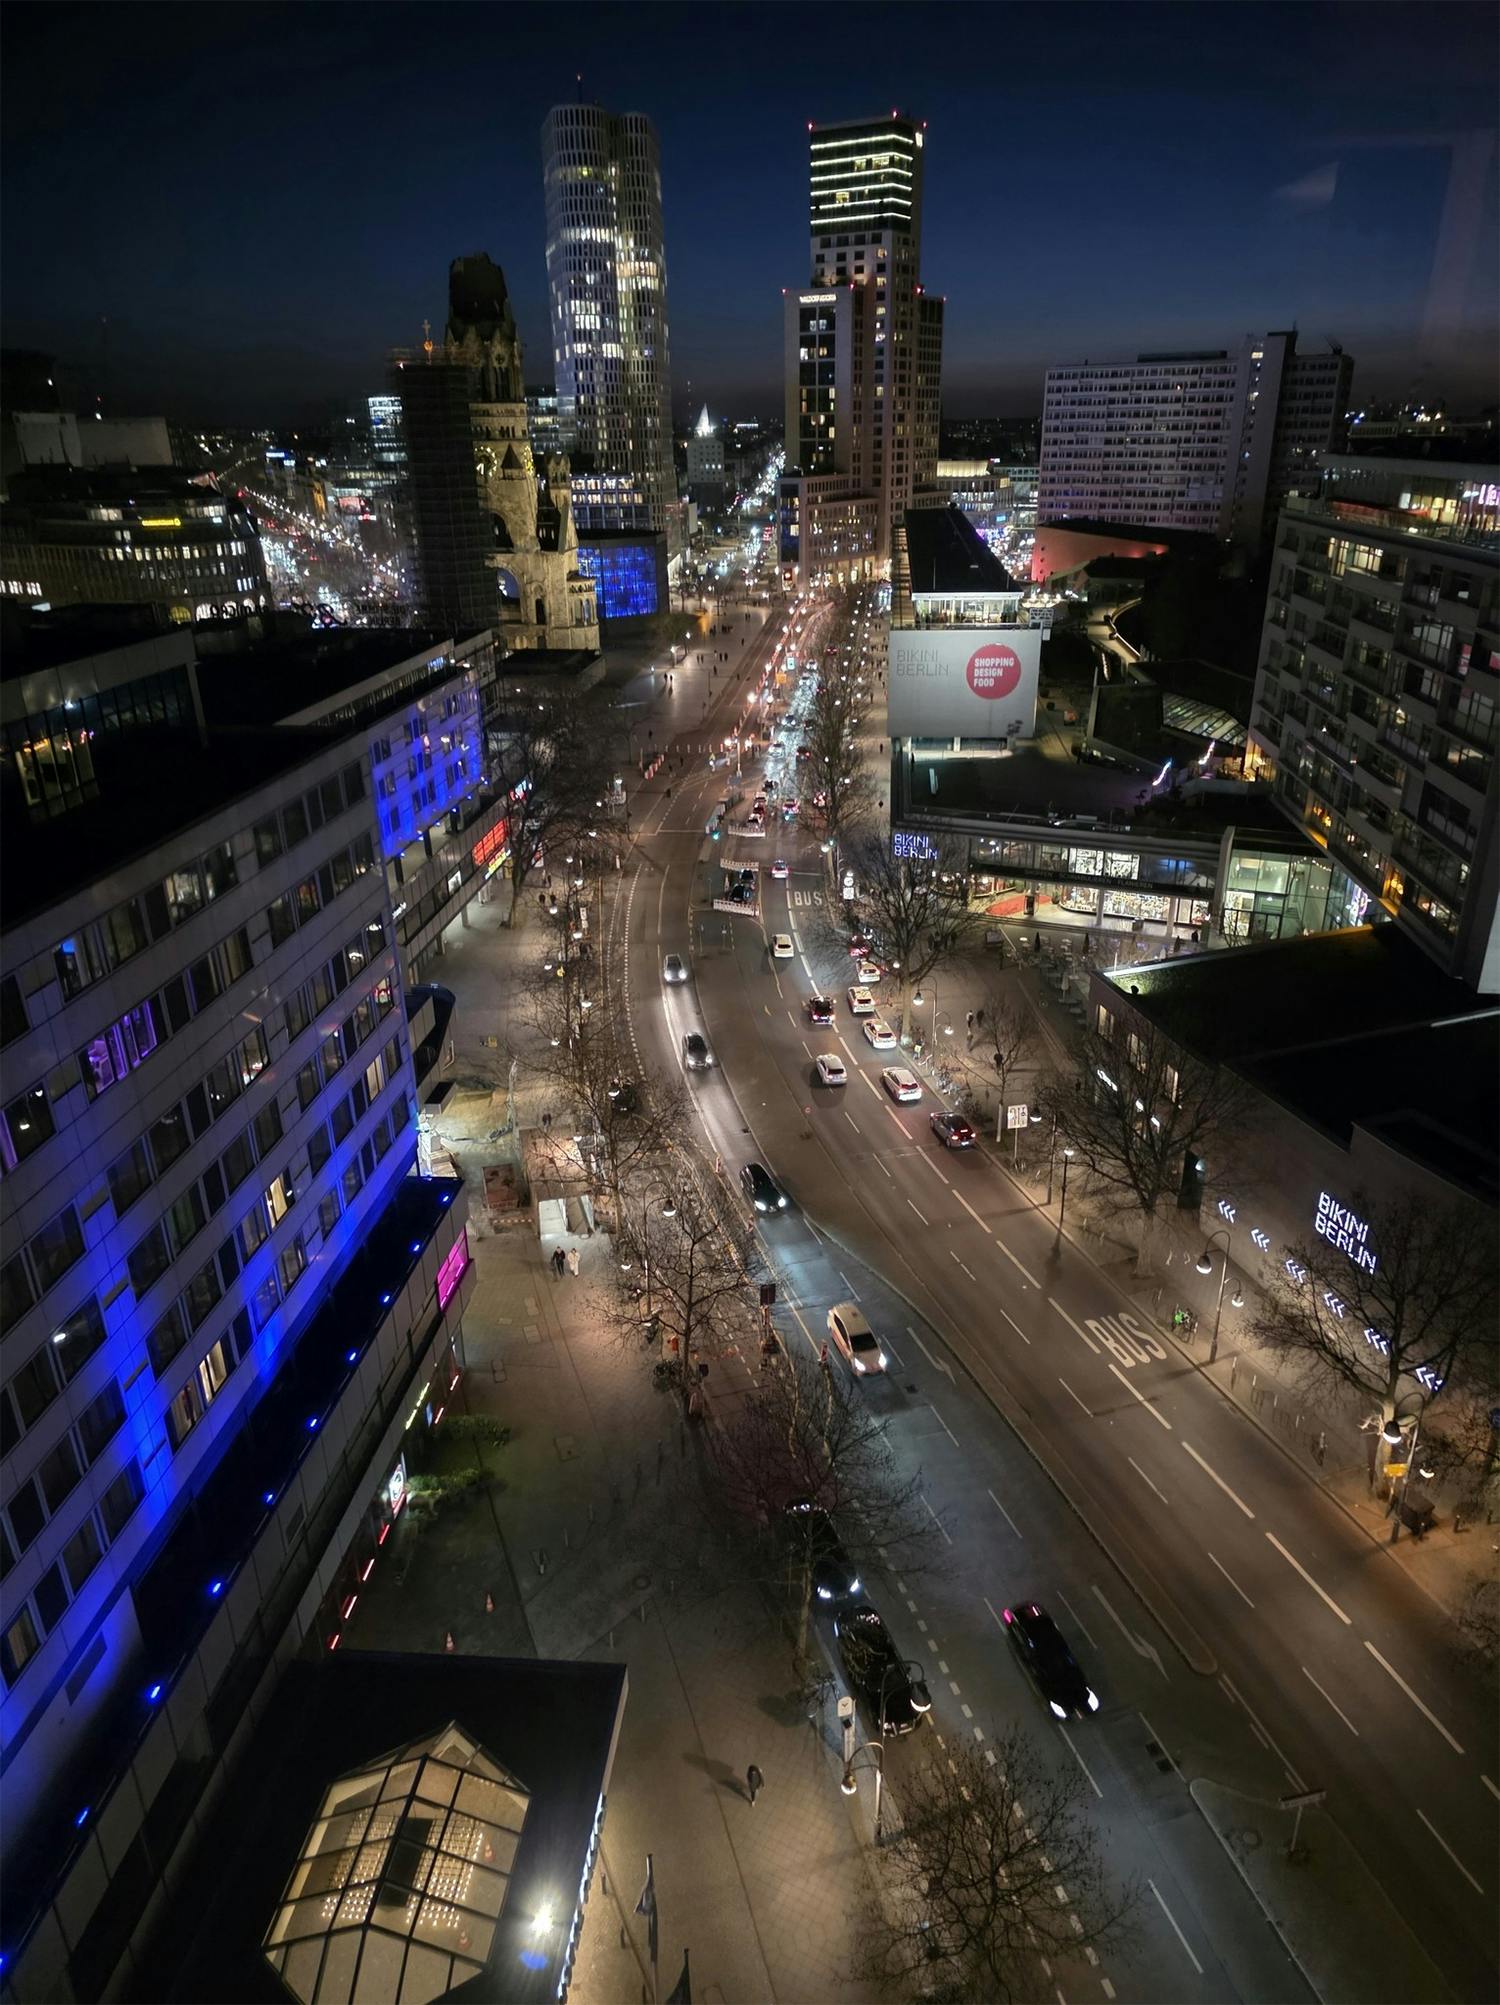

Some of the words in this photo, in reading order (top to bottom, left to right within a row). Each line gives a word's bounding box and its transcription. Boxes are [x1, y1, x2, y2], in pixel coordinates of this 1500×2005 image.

[896, 649, 938, 662] BIKINI
[974, 657, 1015, 668] SHOPPING
[896, 663, 949, 677] BERLIN
[974, 667, 1004, 678] DESIGN
[973, 677, 995, 688] FOOD
[894, 833, 929, 848] BIKINI
[894, 845, 938, 860] BERLIN
[793, 890, 823, 906] BUS
[1318, 1191, 1369, 1243] BIKINI
[1314, 1211, 1377, 1275] BERLIN
[1084, 1312, 1167, 1369] BUS
